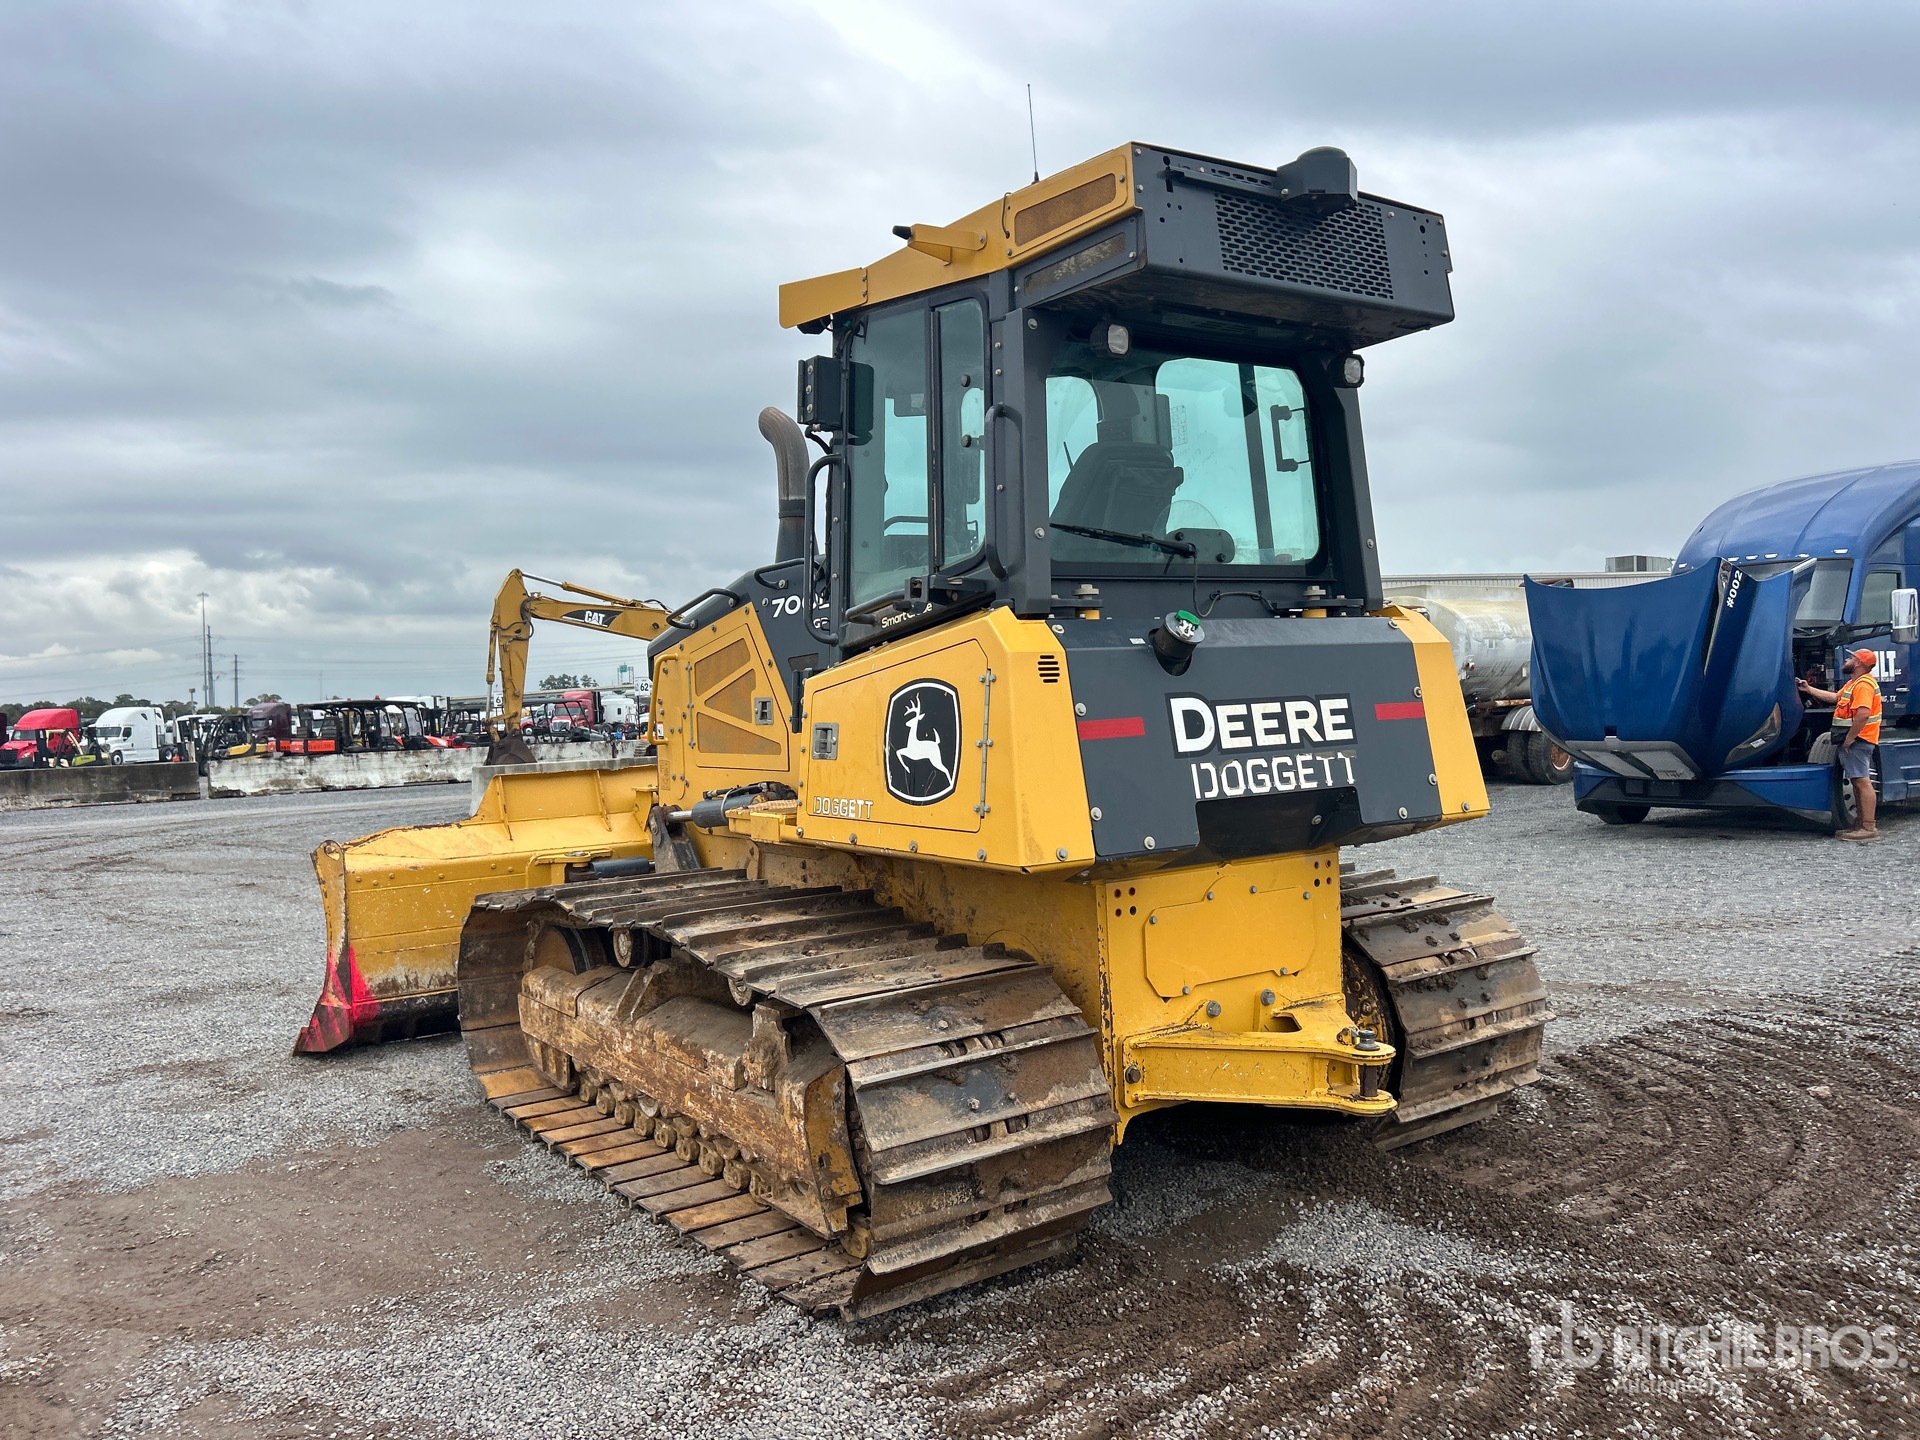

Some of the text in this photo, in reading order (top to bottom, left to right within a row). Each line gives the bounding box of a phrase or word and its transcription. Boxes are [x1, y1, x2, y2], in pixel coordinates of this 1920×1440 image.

[1726, 570, 1743, 608] #002
[584, 610, 605, 625] CAT
[881, 602, 933, 629] Smarte
[640, 682, 650, 692] 62
[1169, 697, 1354, 753] DEERE
[1190, 752, 1356, 800] DOGGETT
[813, 796, 874, 820] DOGGETT
